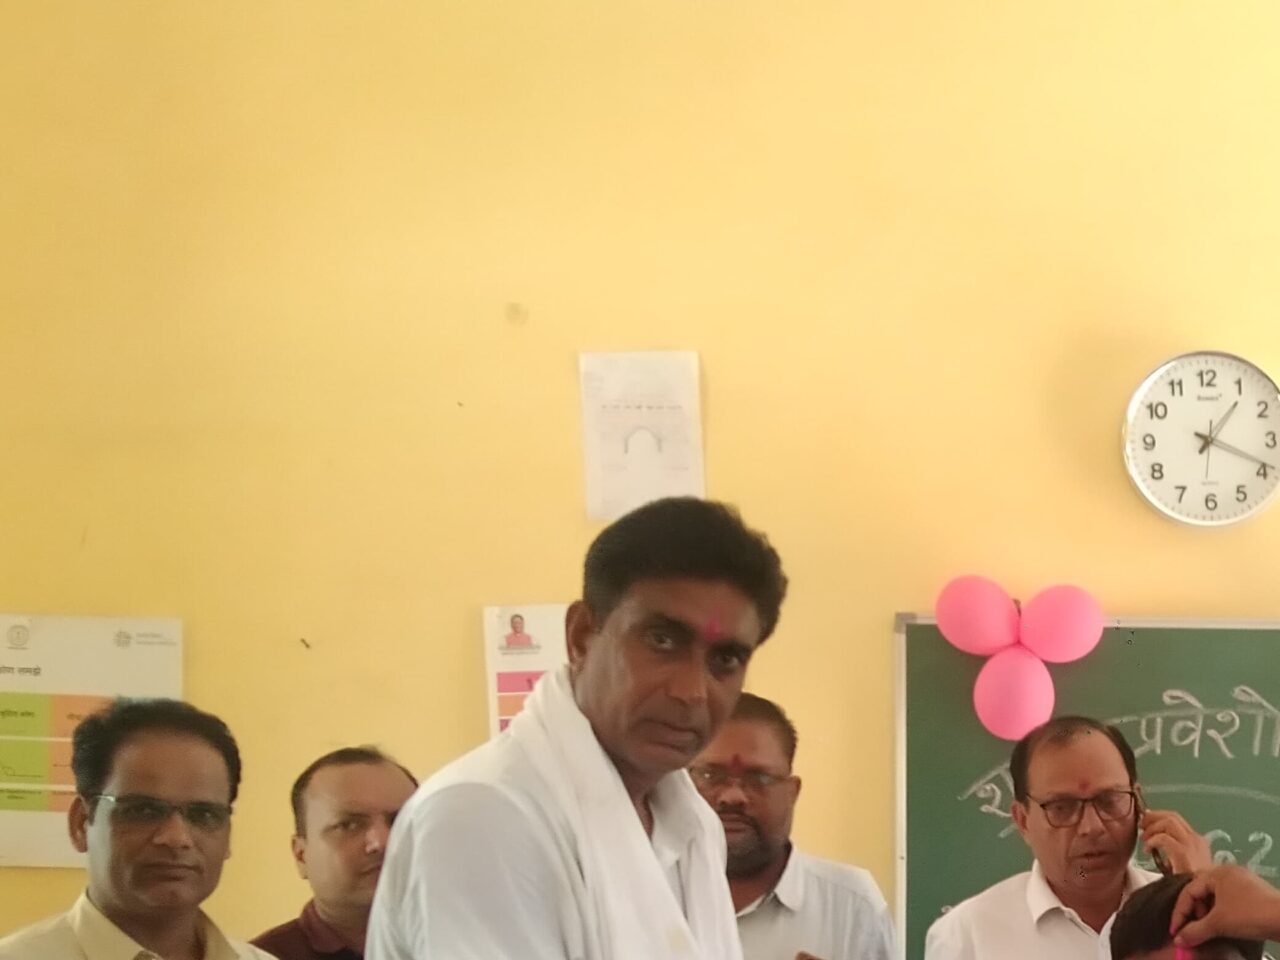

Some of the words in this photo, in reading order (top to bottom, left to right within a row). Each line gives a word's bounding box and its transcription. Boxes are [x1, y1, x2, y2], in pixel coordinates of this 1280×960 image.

[1196, 369, 1217, 388] 12
[1234, 377, 1243, 396] 1
[1168, 379, 1184, 397] 11
[1147, 402, 1168, 420] 10
[1256, 400, 1269, 419] 2
[1142, 433, 1156, 451] 9
[1264, 431, 1277, 449] 3
[1150, 462, 1164, 481] 8
[1256, 462, 1268, 480] 4
[1174, 485, 1187, 504] 7
[1204, 493, 1218, 511] 6
[1235, 484, 1248, 503] 5
